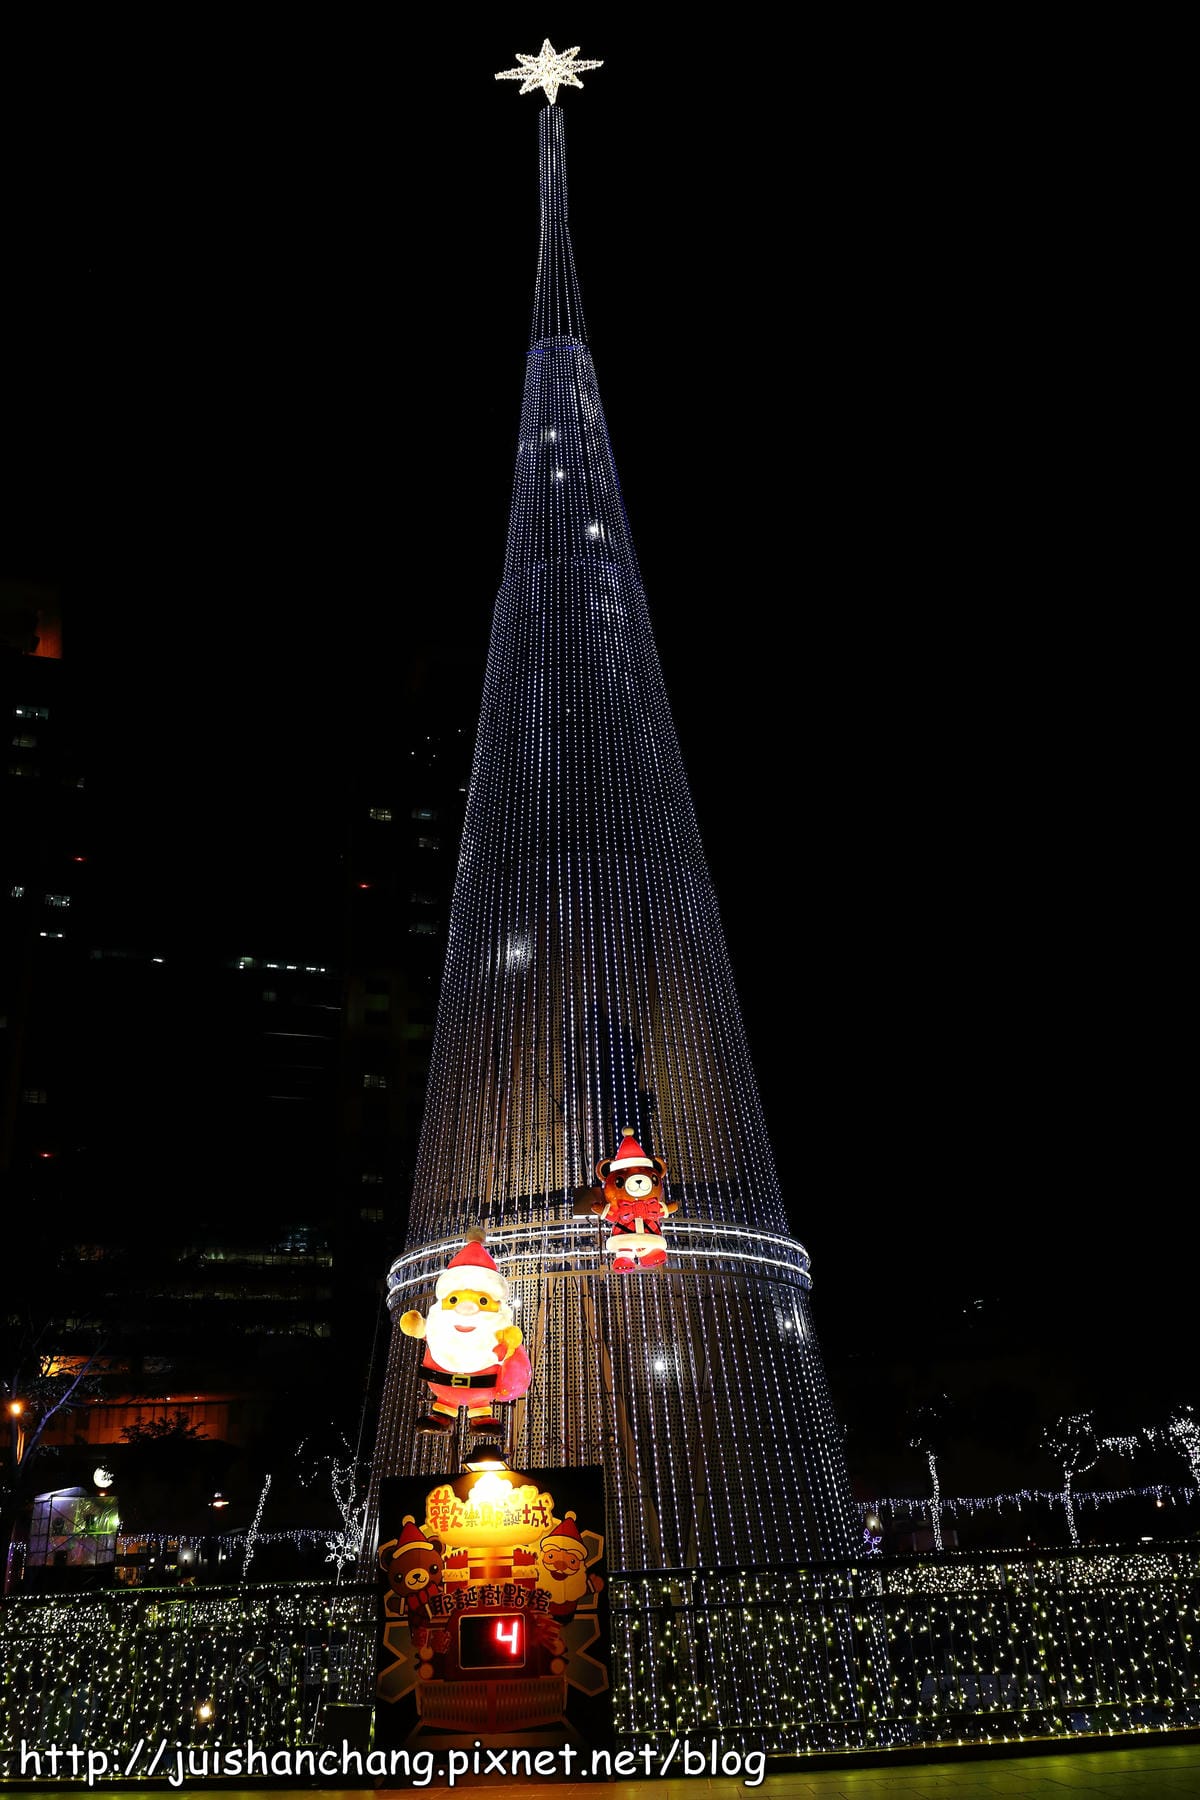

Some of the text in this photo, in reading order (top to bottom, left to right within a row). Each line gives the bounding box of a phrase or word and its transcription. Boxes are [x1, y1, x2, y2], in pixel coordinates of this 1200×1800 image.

[430, 1583, 552, 1615] 耶誕樹點燈
[495, 1619, 519, 1655] 4
